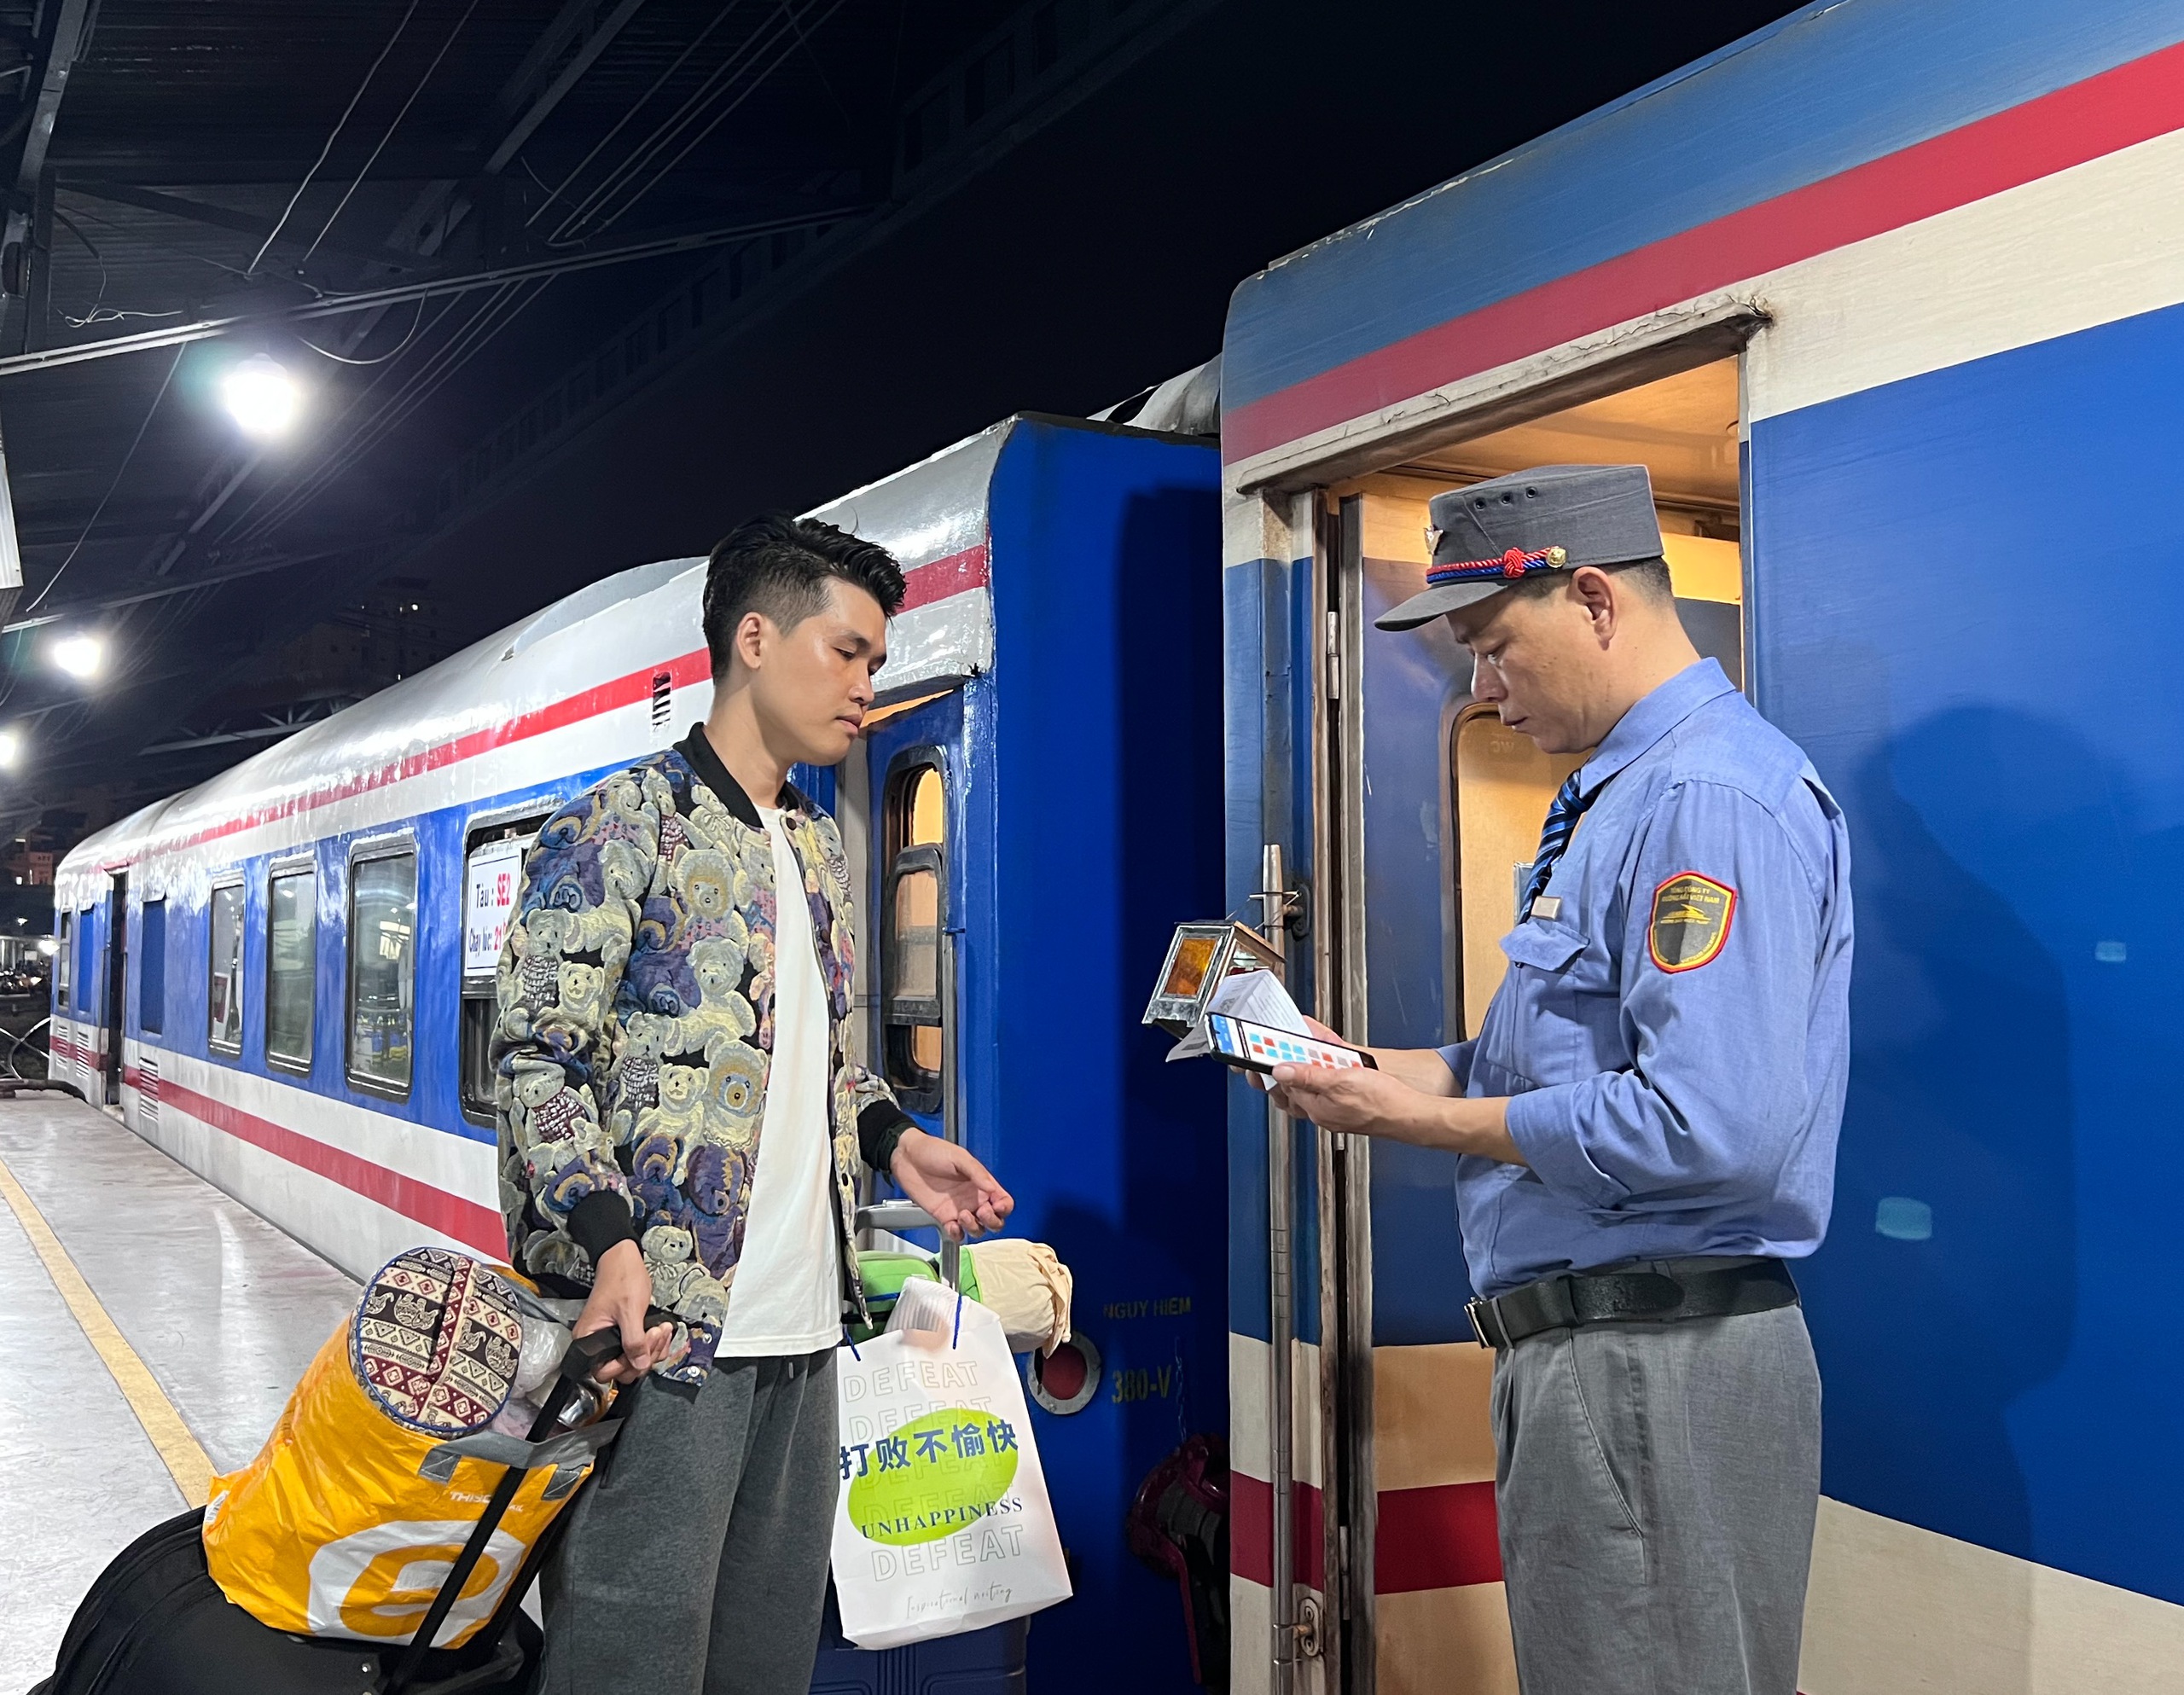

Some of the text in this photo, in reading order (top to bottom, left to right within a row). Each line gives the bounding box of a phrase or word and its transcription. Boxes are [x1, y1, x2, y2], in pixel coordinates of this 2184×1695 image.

[476, 882, 489, 908] Tàu
[497, 873, 511, 907] SE2
[1103, 1300, 1148, 1319] NGUY
[844, 1361, 978, 1403] DEFEAT
[1112, 1365, 1171, 1403] 380-V
[839, 1419, 1019, 1480] 打败不愉快
[861, 1497, 1023, 1539] UNHAPPINESS
[871, 1524, 1023, 1582] DEFEAT
